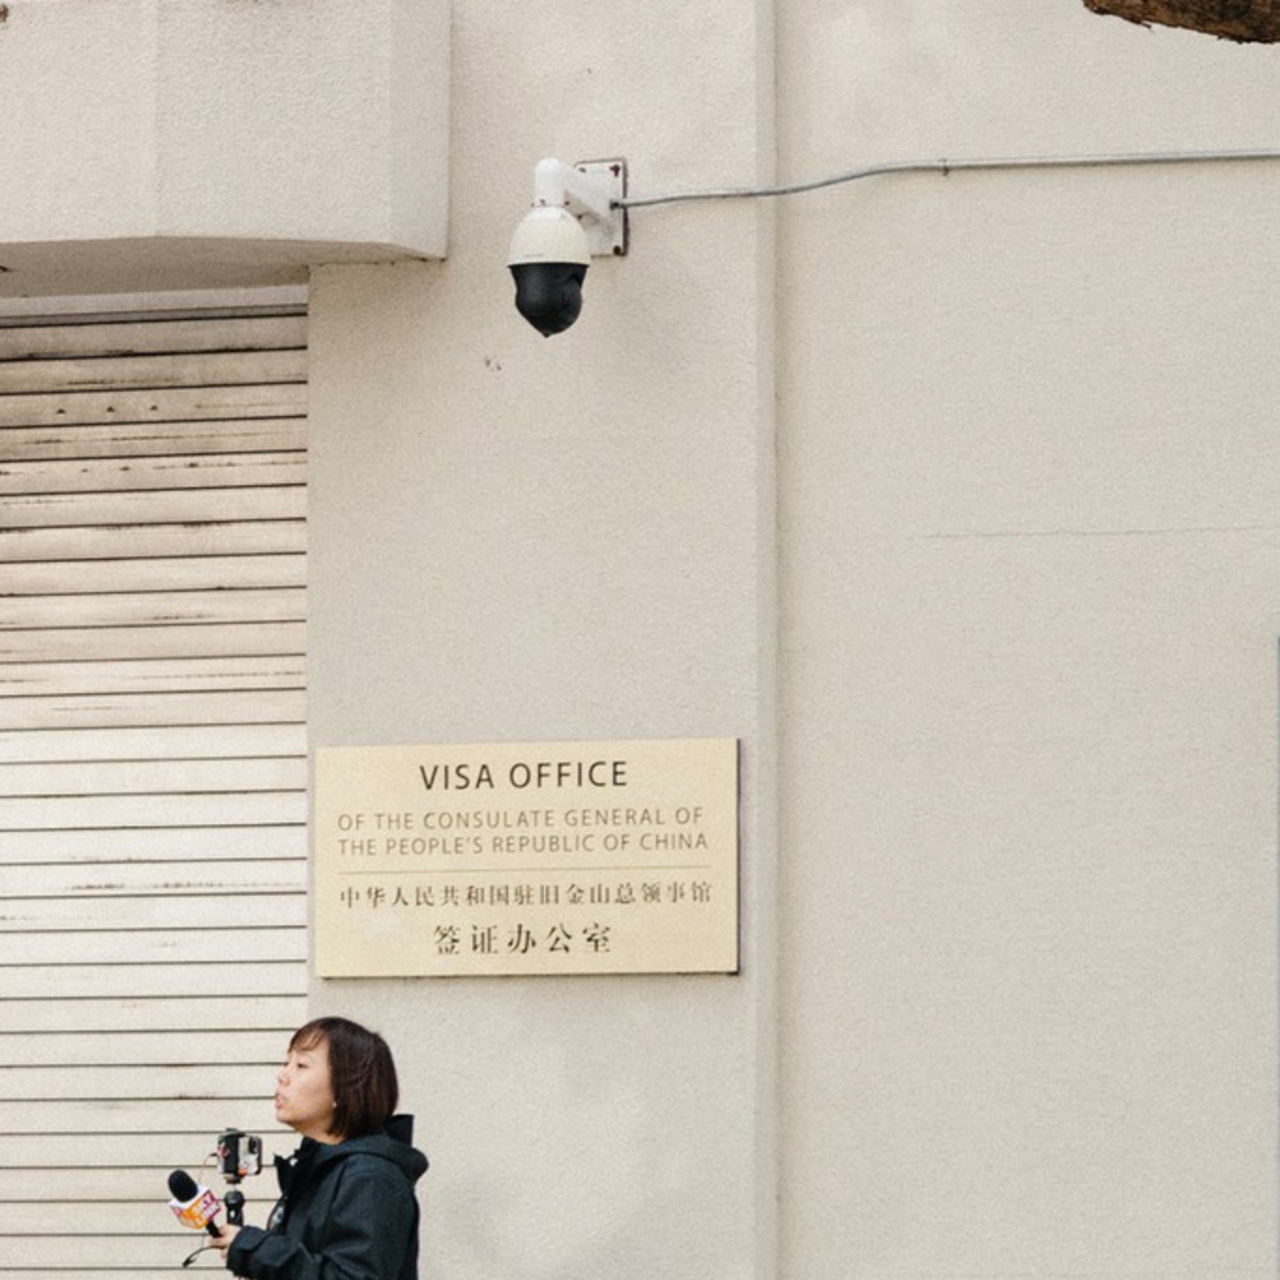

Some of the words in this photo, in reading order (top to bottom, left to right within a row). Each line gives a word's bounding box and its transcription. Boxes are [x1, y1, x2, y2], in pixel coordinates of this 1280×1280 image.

[419, 763, 495, 790] VISA
[508, 761, 628, 789] OFFICE
[337, 813, 365, 831] OF
[374, 812, 414, 830] THE
[423, 809, 555, 829] CONSULATE
[563, 807, 666, 827] GENERAL
[674, 806, 704, 825] OF
[337, 838, 377, 856] THE
[385, 836, 484, 855] PEOPLE'S
[492, 833, 595, 853] REPUBLIC
[602, 833, 631, 851] OF
[639, 831, 709, 851] CHINA
[340, 880, 712, 909] 中华人民共和国驻旧金山总领事馆
[432, 921, 611, 955] 签证办公室
